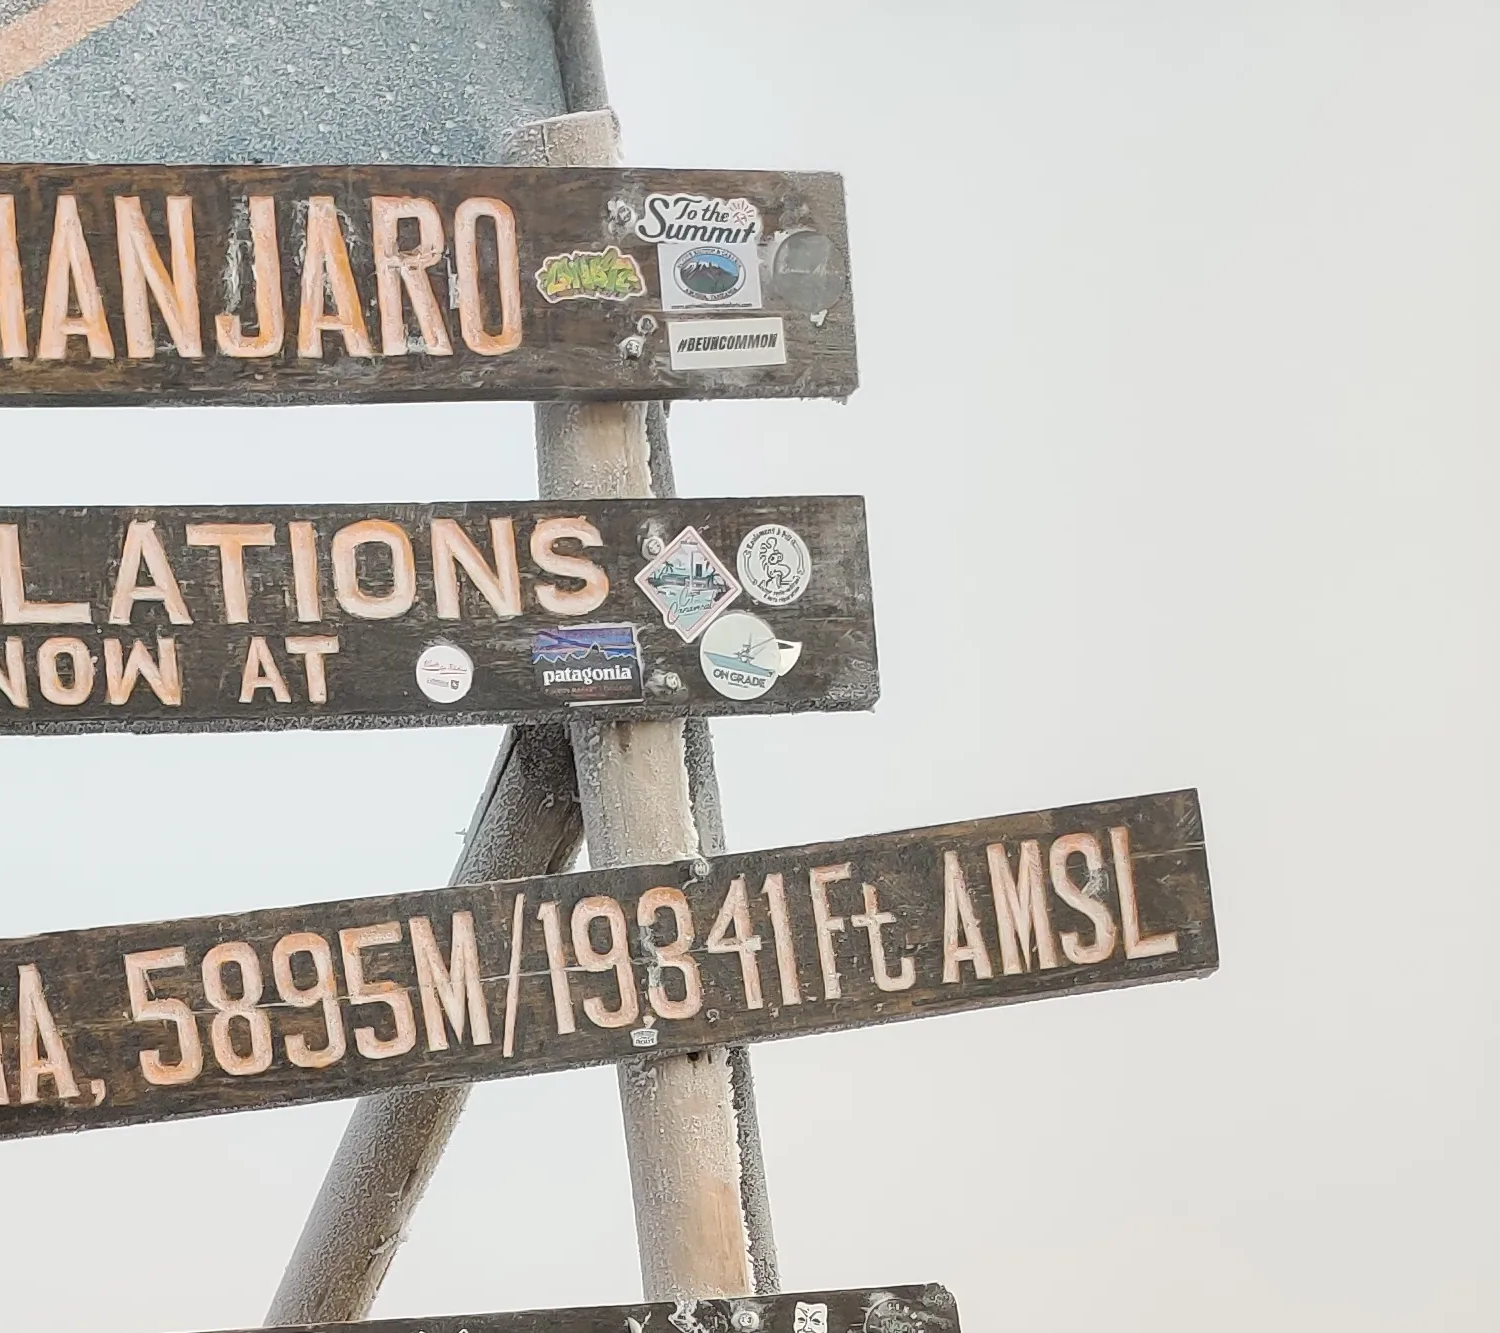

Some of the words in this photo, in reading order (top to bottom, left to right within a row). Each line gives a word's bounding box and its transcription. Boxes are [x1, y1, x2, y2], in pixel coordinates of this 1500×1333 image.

[638, 197, 757, 243] Summit
[673, 197, 703, 221] To
[697, 201, 730, 223] the
[676, 332, 779, 354] #BEUNCOMMON
[237, 635, 342, 707] AT
[543, 664, 633, 687] patagonia
[712, 667, 730, 682] ON
[729, 670, 766, 689] GRADE
[941, 825, 1179, 985] AMSL
